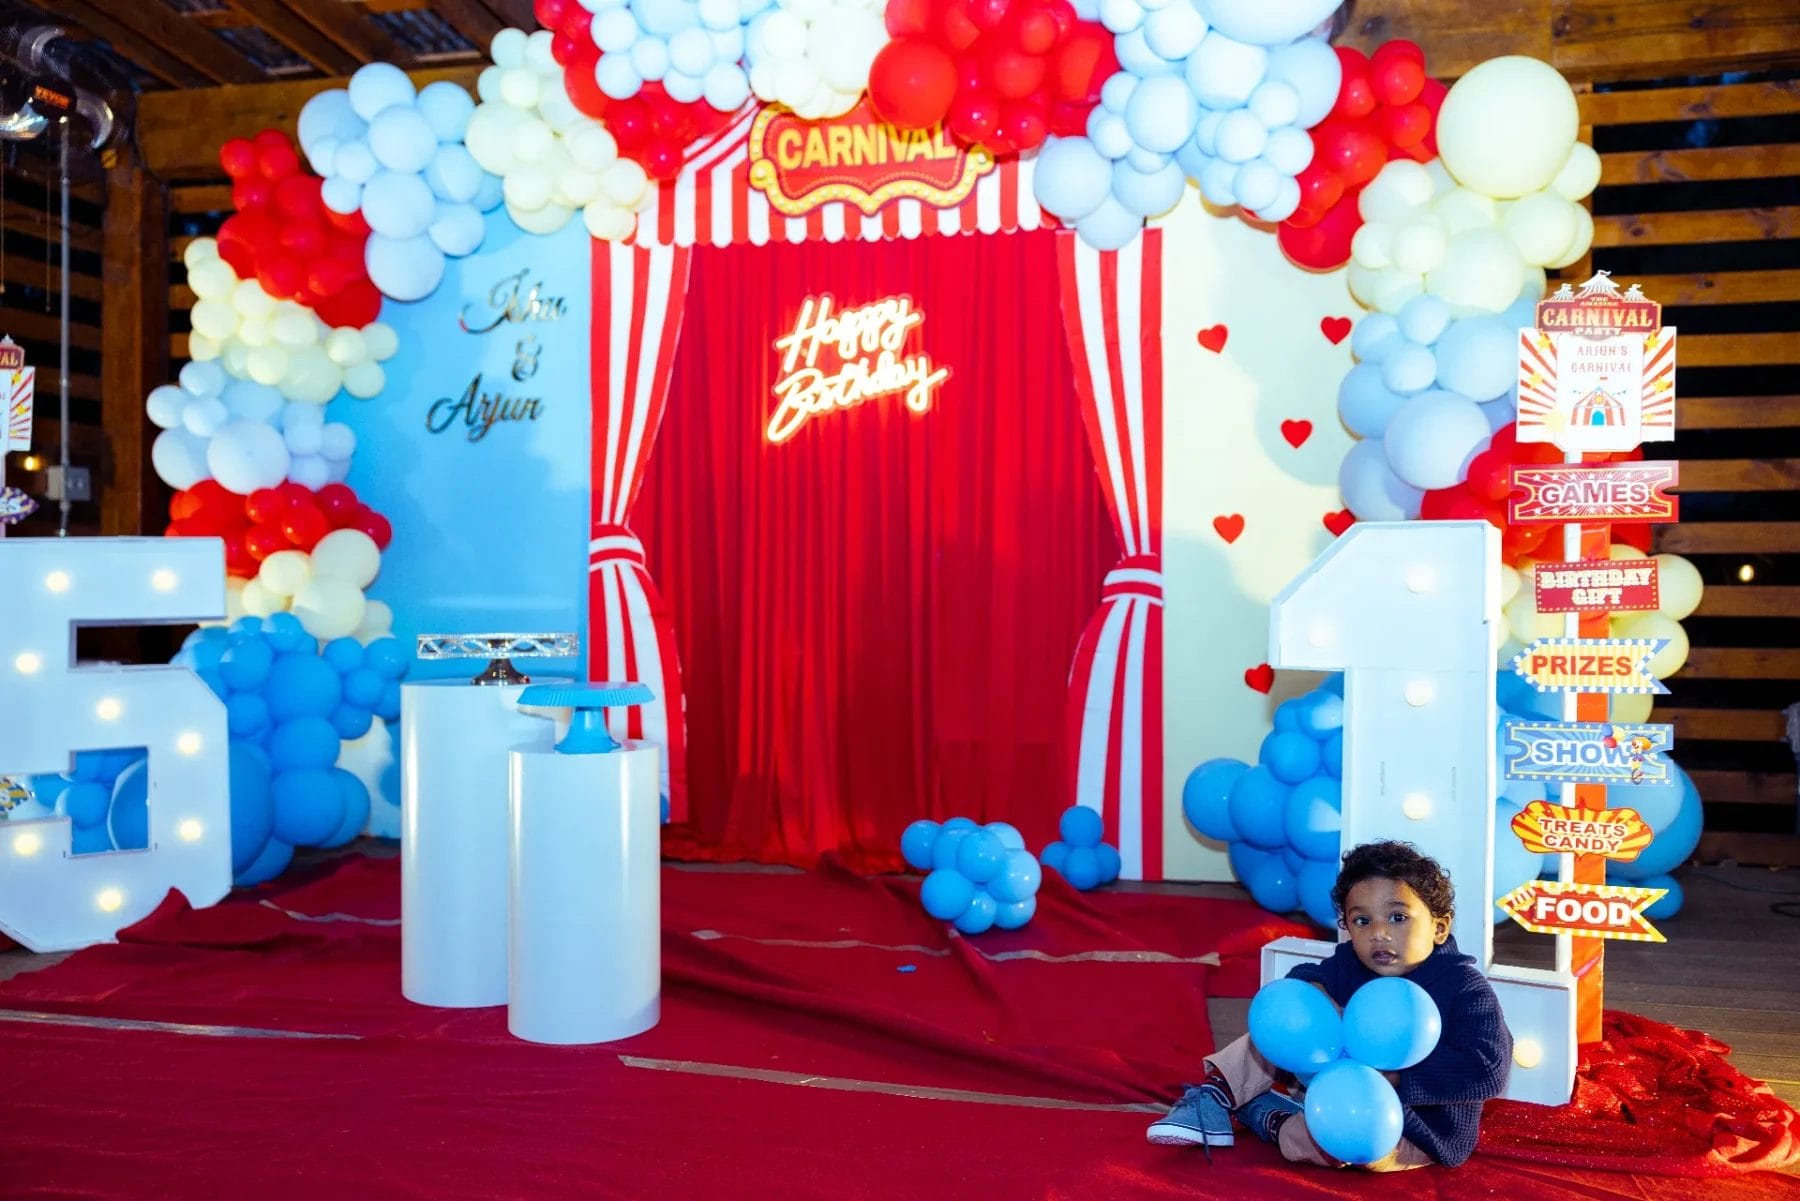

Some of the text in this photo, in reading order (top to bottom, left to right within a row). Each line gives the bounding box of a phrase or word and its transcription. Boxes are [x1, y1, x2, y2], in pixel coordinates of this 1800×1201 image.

[777, 115, 957, 170] CARNIVAL
[1542, 308, 1653, 327] CARNIVAL
[774, 295, 921, 373] Happy
[1574, 327, 1621, 337] PARTY
[766, 350, 949, 443] Birthday
[1538, 481, 1649, 505] GAMES
[1540, 567, 1653, 589] BIRTHDAY
[1571, 587, 1623, 605] GIFT
[1531, 655, 1632, 676] PRIZES
[1532, 740, 1634, 767] SHOW
[1538, 818, 1627, 838] TREATS
[1543, 834, 1619, 852] CANDY
[1536, 897, 1632, 926] FOOD
